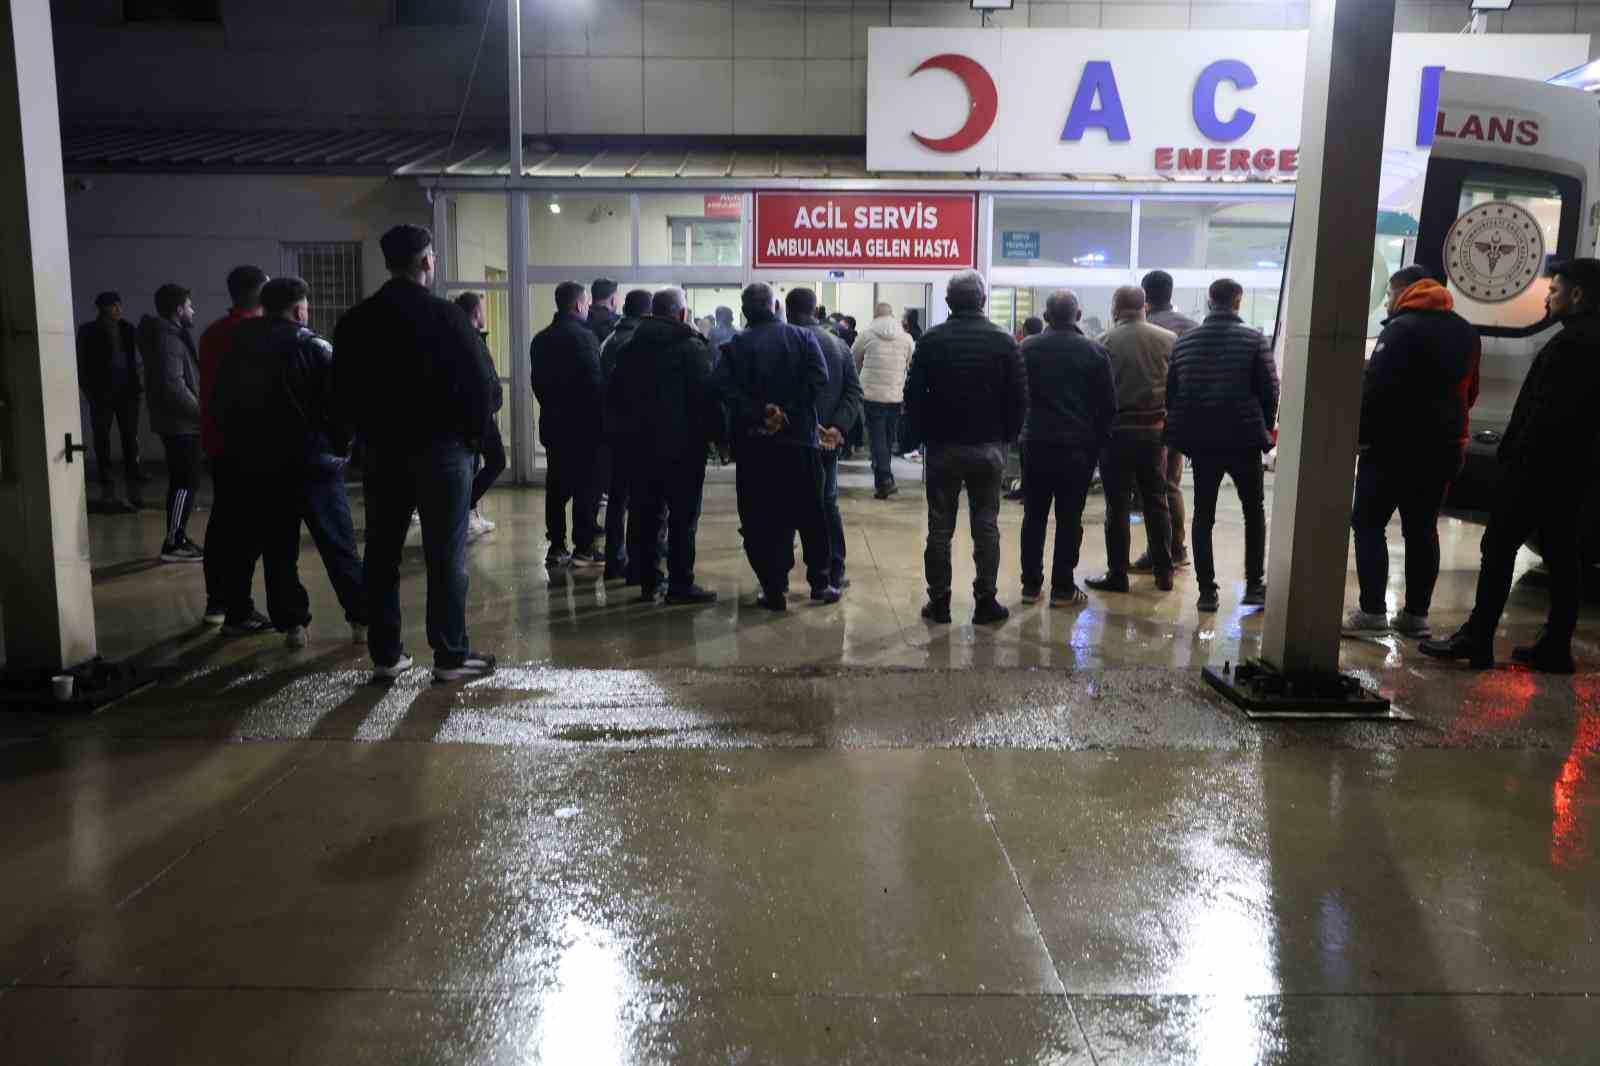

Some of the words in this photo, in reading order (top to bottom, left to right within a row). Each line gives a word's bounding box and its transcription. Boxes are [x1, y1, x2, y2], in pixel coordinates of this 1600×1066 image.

[1435, 111, 1539, 145] LANS
[794, 201, 848, 229] ACİL
[853, 202, 938, 229] SERVİS
[766, 238, 862, 257] AMBULANSLA
[866, 239, 910, 257] GELEN
[914, 239, 960, 258] HASTA
